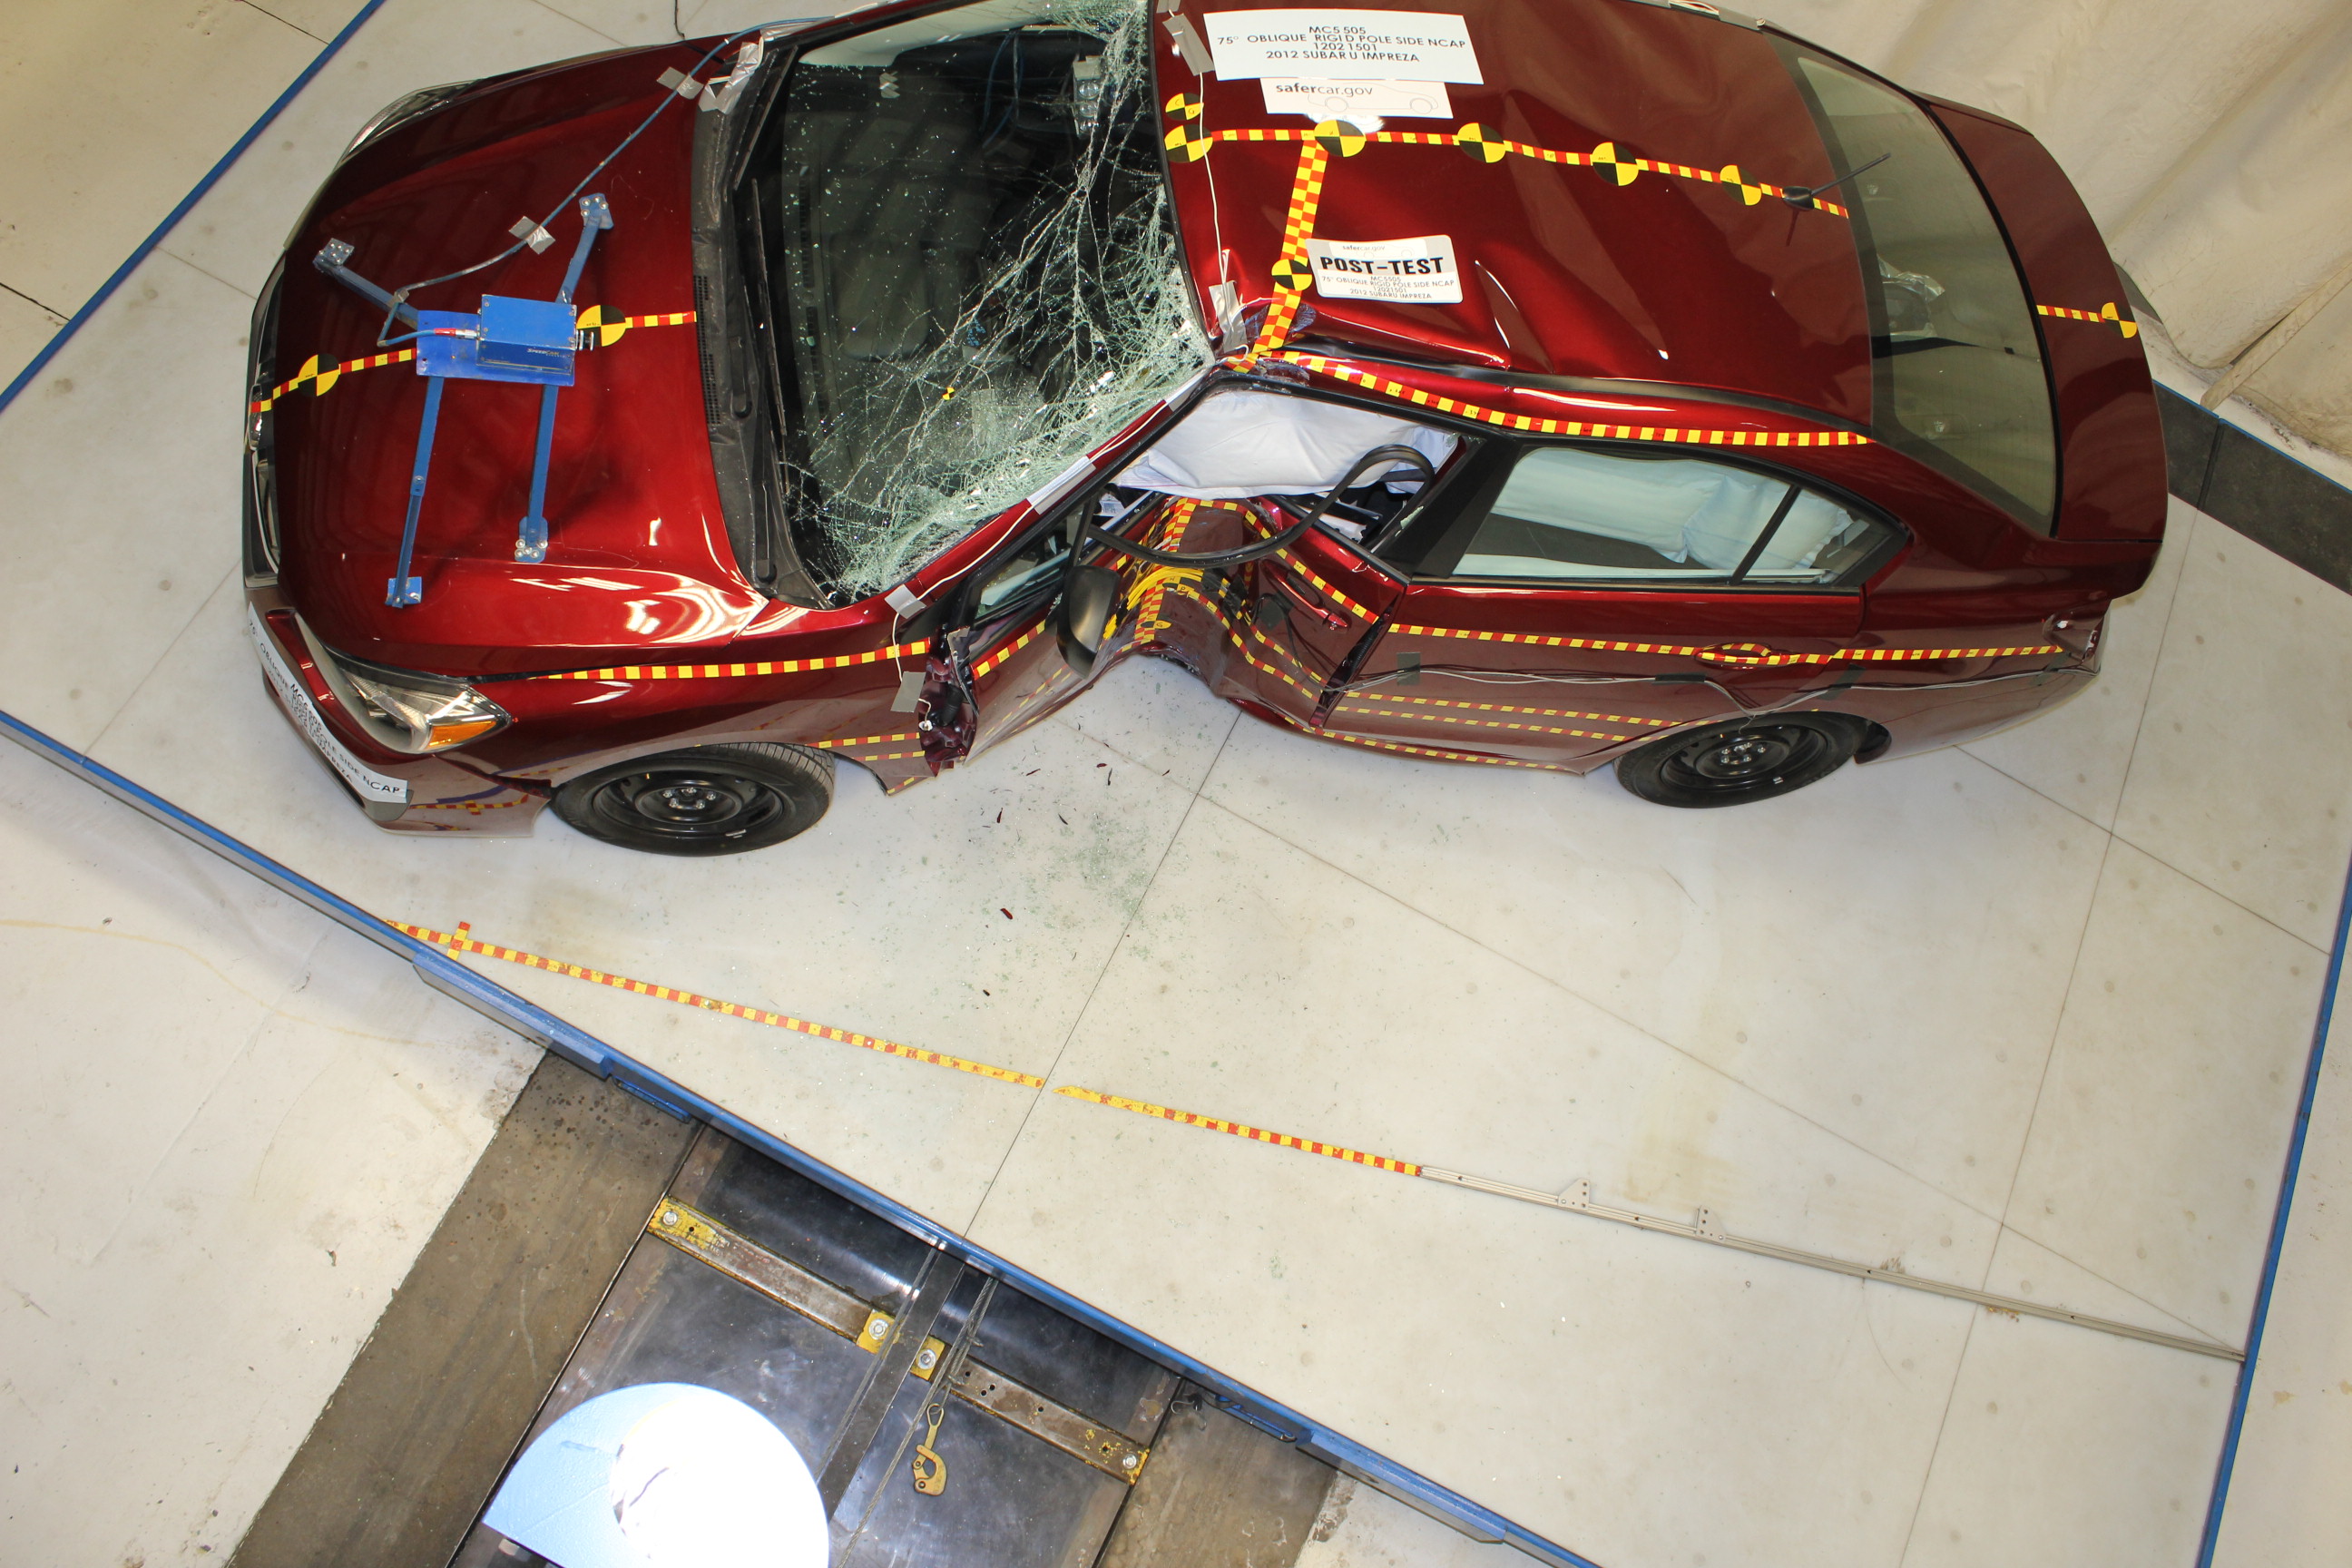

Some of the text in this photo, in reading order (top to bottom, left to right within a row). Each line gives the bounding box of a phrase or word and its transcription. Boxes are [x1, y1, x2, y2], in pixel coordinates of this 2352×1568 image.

[1247, 34, 1308, 43] OBLIQUE
[1358, 34, 1392, 44] POLE
[1396, 36, 1424, 45] SIDE
[1427, 38, 1466, 48] NCAP
[1266, 50, 1298, 59] 2012
[1362, 52, 1420, 63] IMPREZA
[1276, 83, 1373, 97] safercar.gov
[1342, 244, 1386, 252] safercar.gov
[1319, 256, 1444, 275] POST-TEST
[1336, 277, 1368, 286] OBLIQUE
[1393, 280, 1412, 289] POLE
[1413, 280, 1431, 289] SIDE
[1432, 279, 1455, 288] NCAP
[1349, 288, 1367, 296] 2012
[1368, 290, 1398, 299] SUBARU
[363, 775, 400, 795] NCAP
